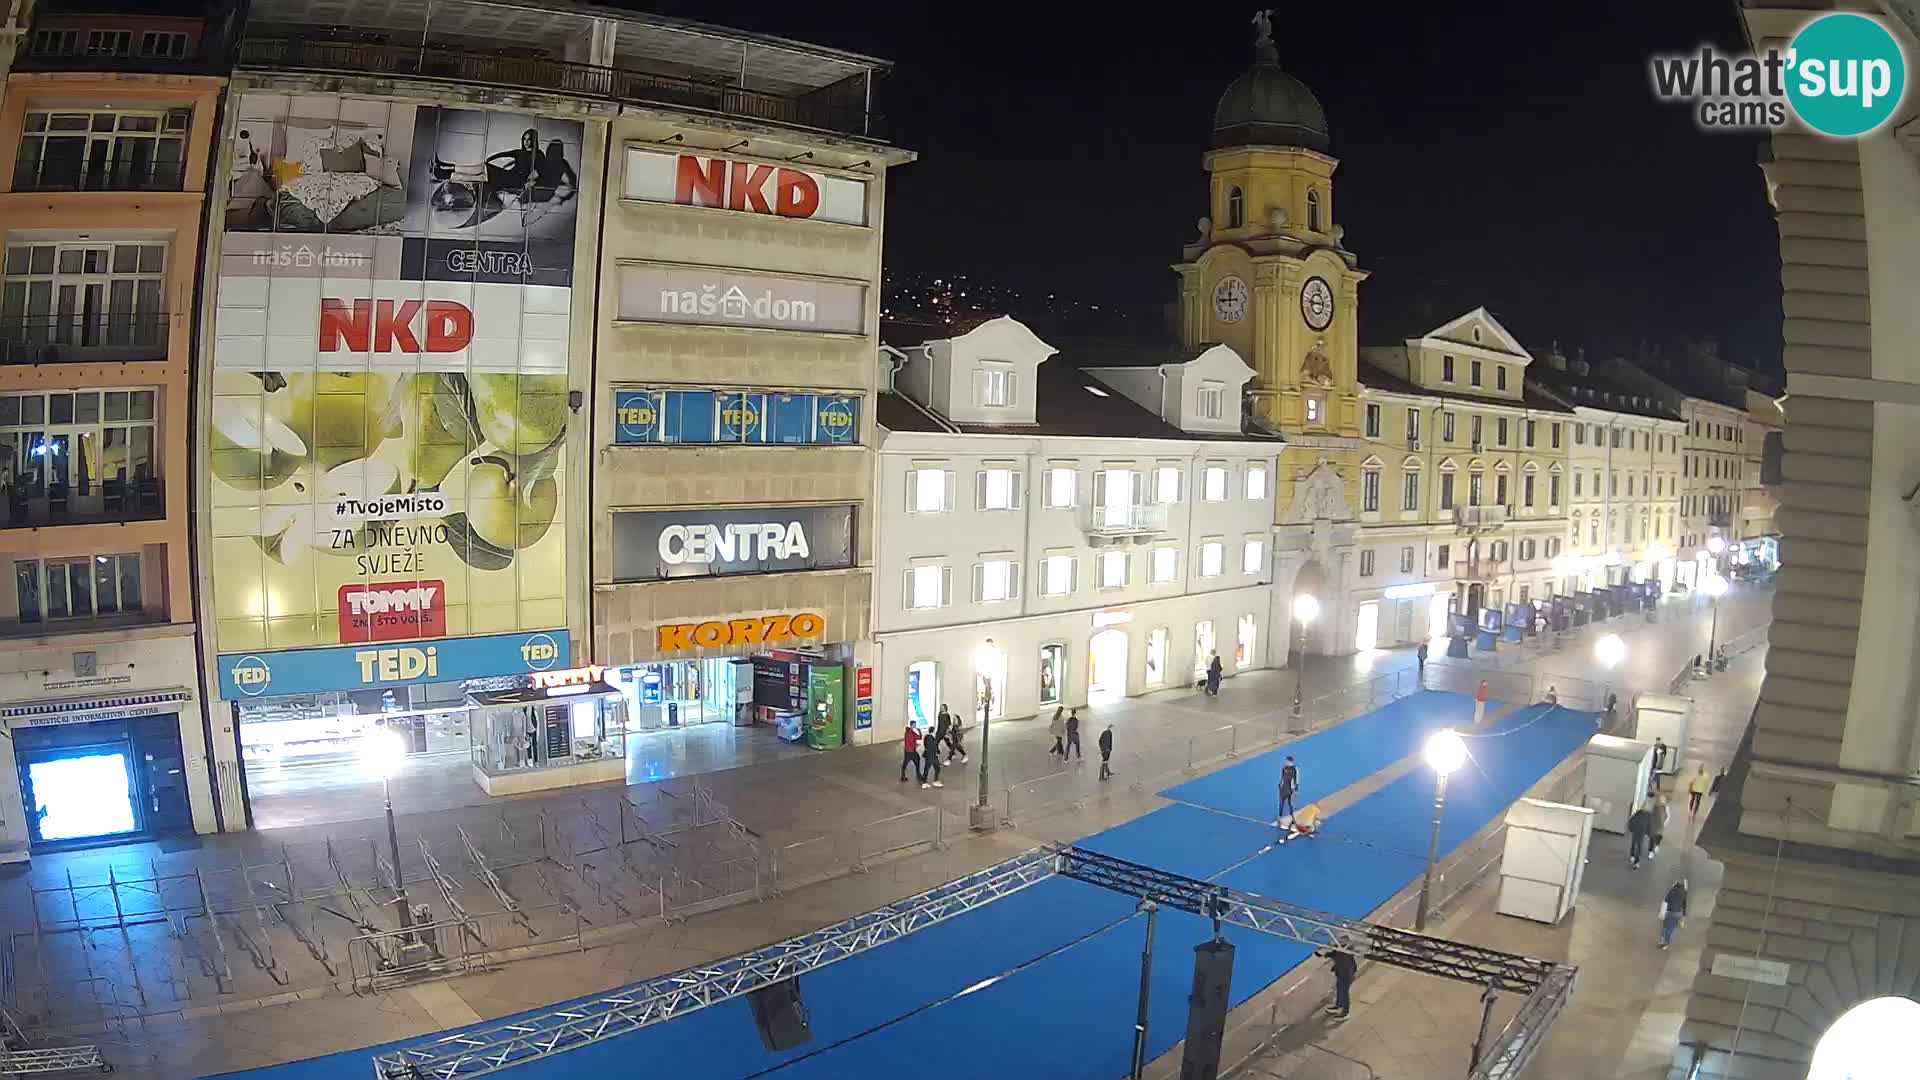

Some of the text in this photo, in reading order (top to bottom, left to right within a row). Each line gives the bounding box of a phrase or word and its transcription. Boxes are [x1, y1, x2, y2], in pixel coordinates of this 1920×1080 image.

[675, 155, 819, 218] NKD
[252, 245, 363, 267] naš dom
[446, 249, 533, 275] CENTRA
[660, 284, 816, 322] naš dom
[319, 297, 474, 353] NKD
[617, 408, 657, 425] TEDi
[723, 409, 759, 425] TEDi
[819, 411, 853, 426] TEDi
[336, 497, 444, 516] #TvojeMisto
[331, 523, 449, 549] ZA DNEVNO
[658, 520, 809, 565] CENTRA
[357, 547, 424, 576] SVJEŽE
[346, 587, 438, 615] TOMMY
[658, 612, 825, 652] KORZO
[355, 646, 438, 683] TEDi
[520, 643, 559, 662] TEDi
[232, 665, 271, 685] TEDi
[531, 664, 604, 690] TOMMY
